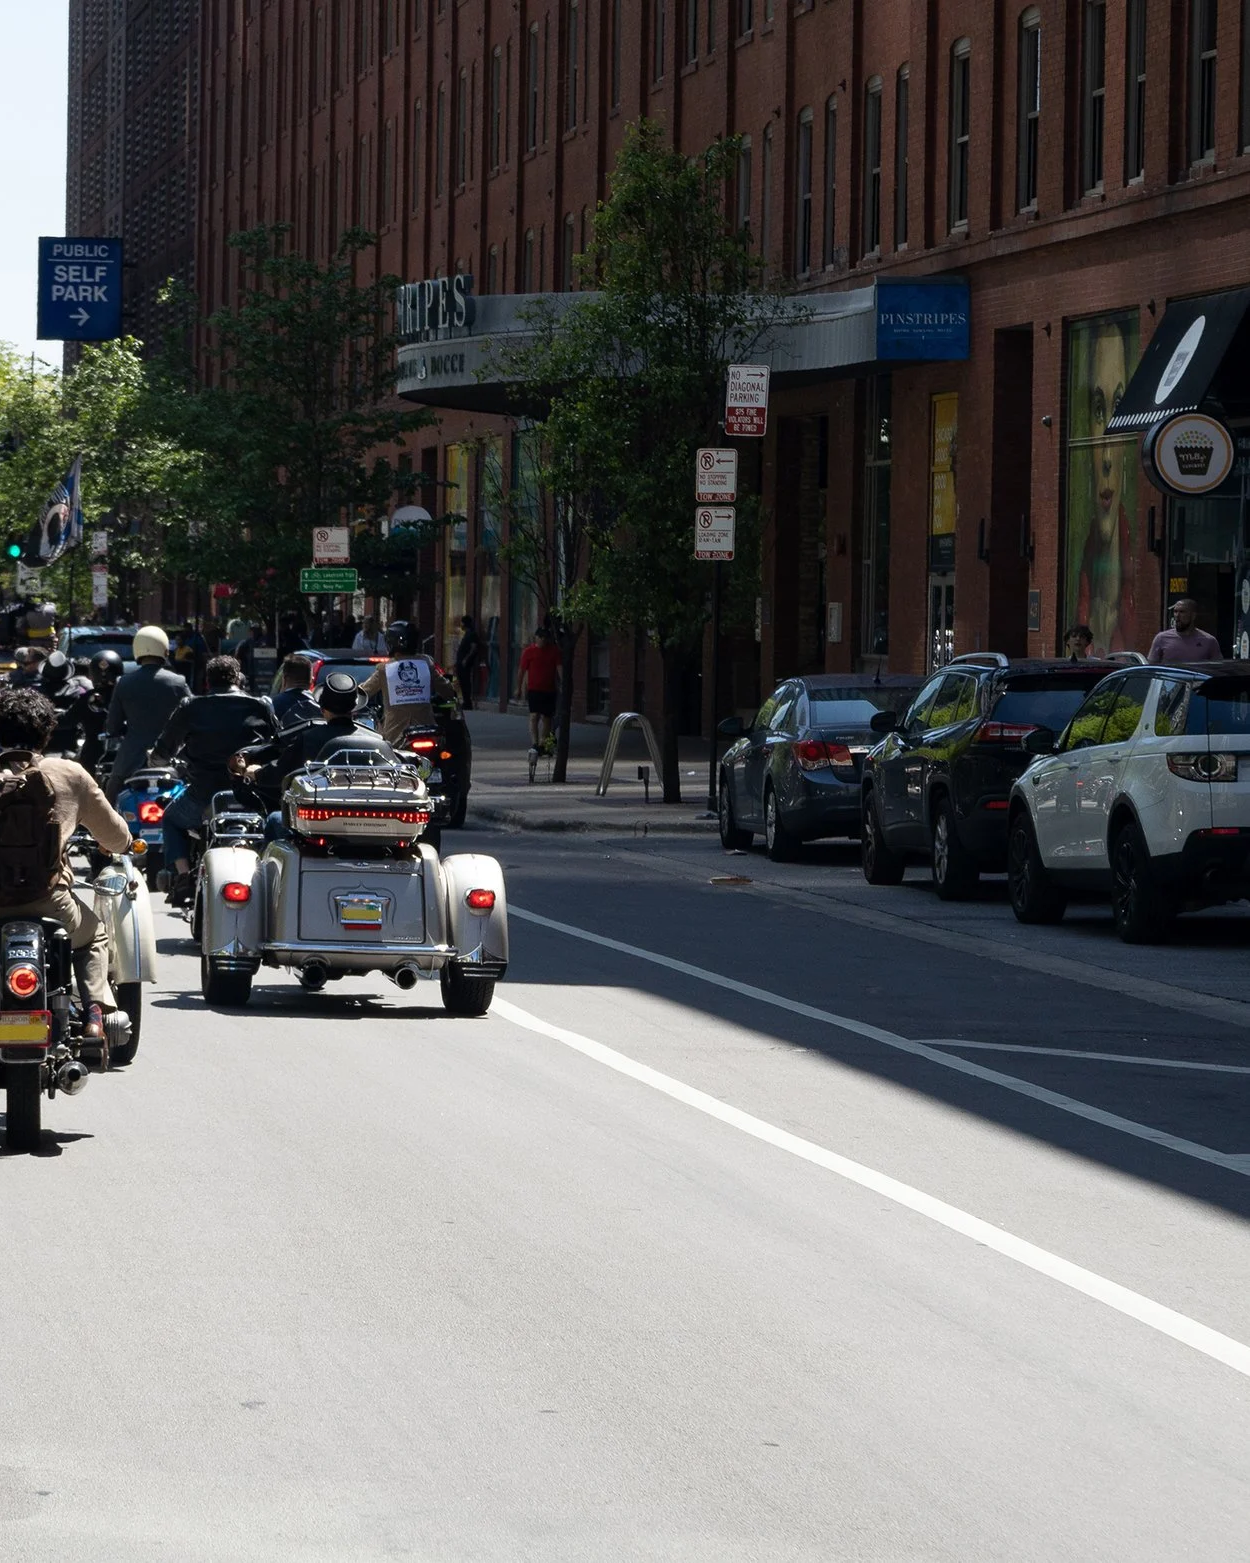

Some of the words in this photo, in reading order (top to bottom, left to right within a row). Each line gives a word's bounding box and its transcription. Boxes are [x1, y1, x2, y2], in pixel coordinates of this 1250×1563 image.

[52, 244, 109, 257] PUBLIC
[54, 265, 107, 283] SELF
[51, 285, 109, 302] PARK
[881, 312, 966, 325] PINSTRIPES
[731, 370, 741, 380] NO
[730, 382, 765, 392] DIAGONAL
[730, 393, 760, 404] PARKING
